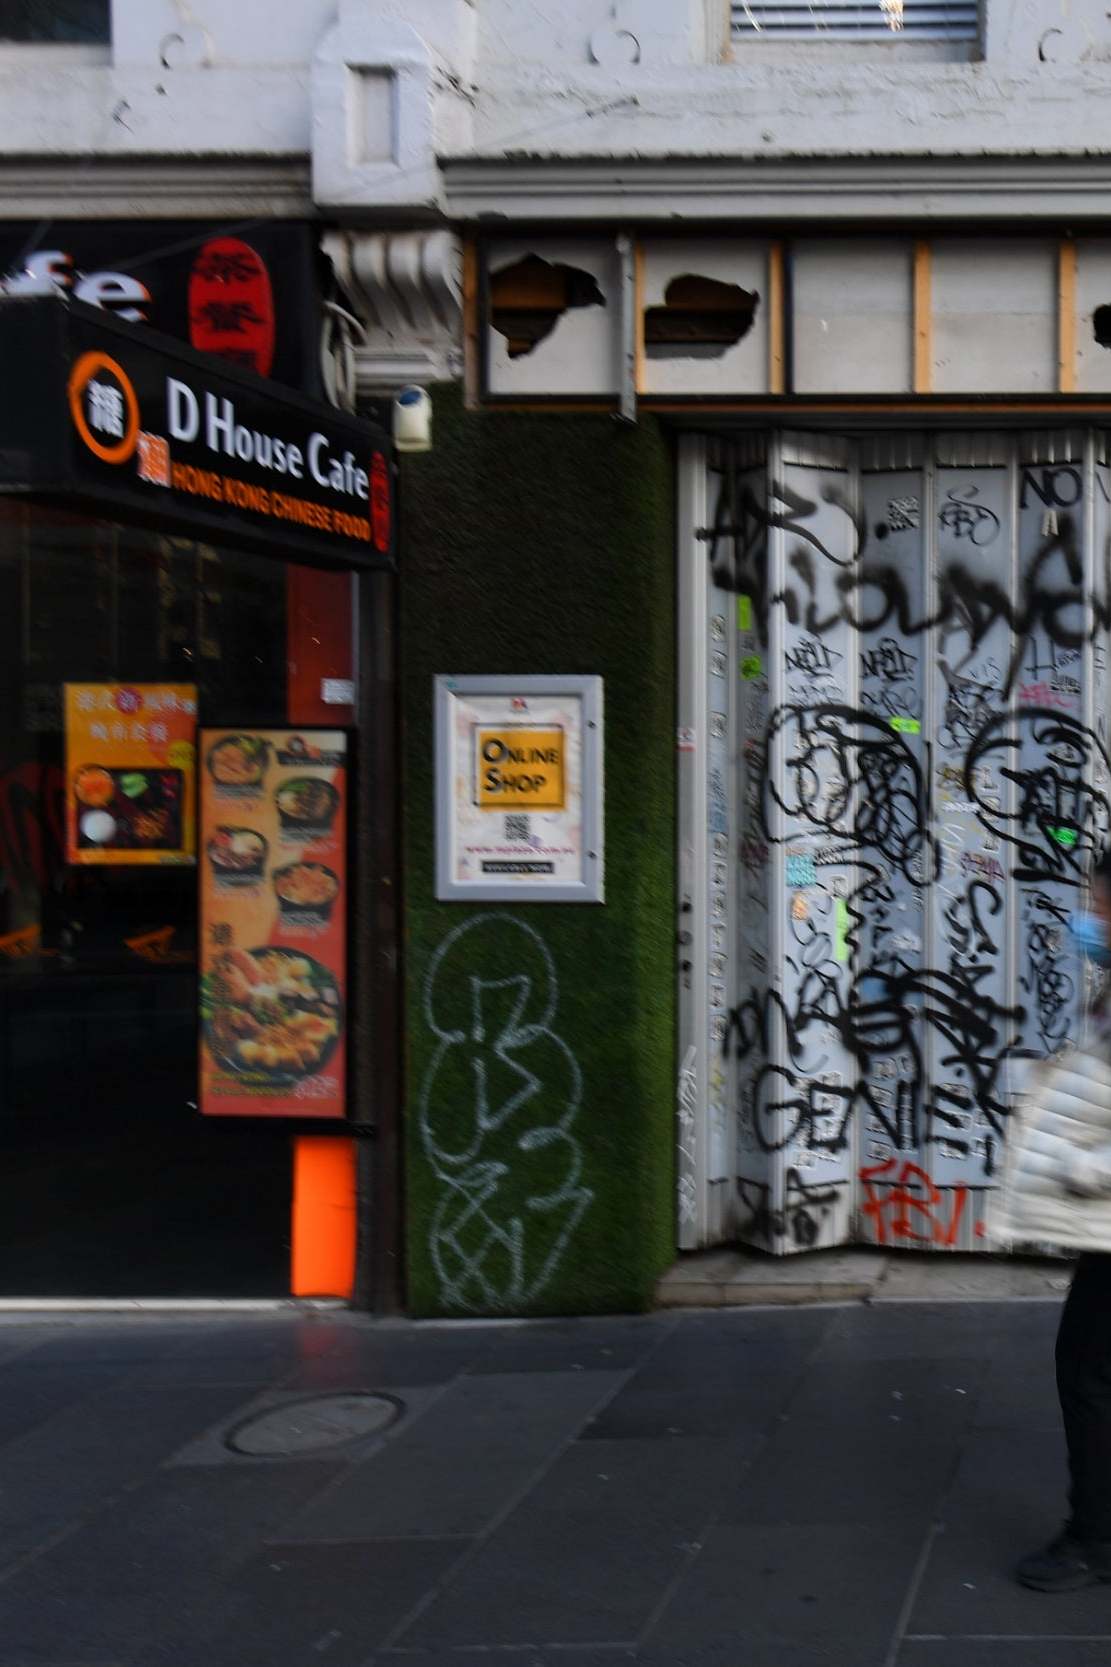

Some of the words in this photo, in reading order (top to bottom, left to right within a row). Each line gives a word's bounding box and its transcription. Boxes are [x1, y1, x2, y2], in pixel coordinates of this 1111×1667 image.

[166, 376, 200, 444] D
[205, 391, 304, 480] House
[307, 431, 370, 501] Cafe
[171, 462, 222, 500] HONG
[225, 476, 272, 516] KONG
[271, 490, 333, 532] CHINESE
[333, 512, 372, 542] FOOD
[482, 738, 560, 765] ONLINE
[483, 767, 547, 794] SHOP
